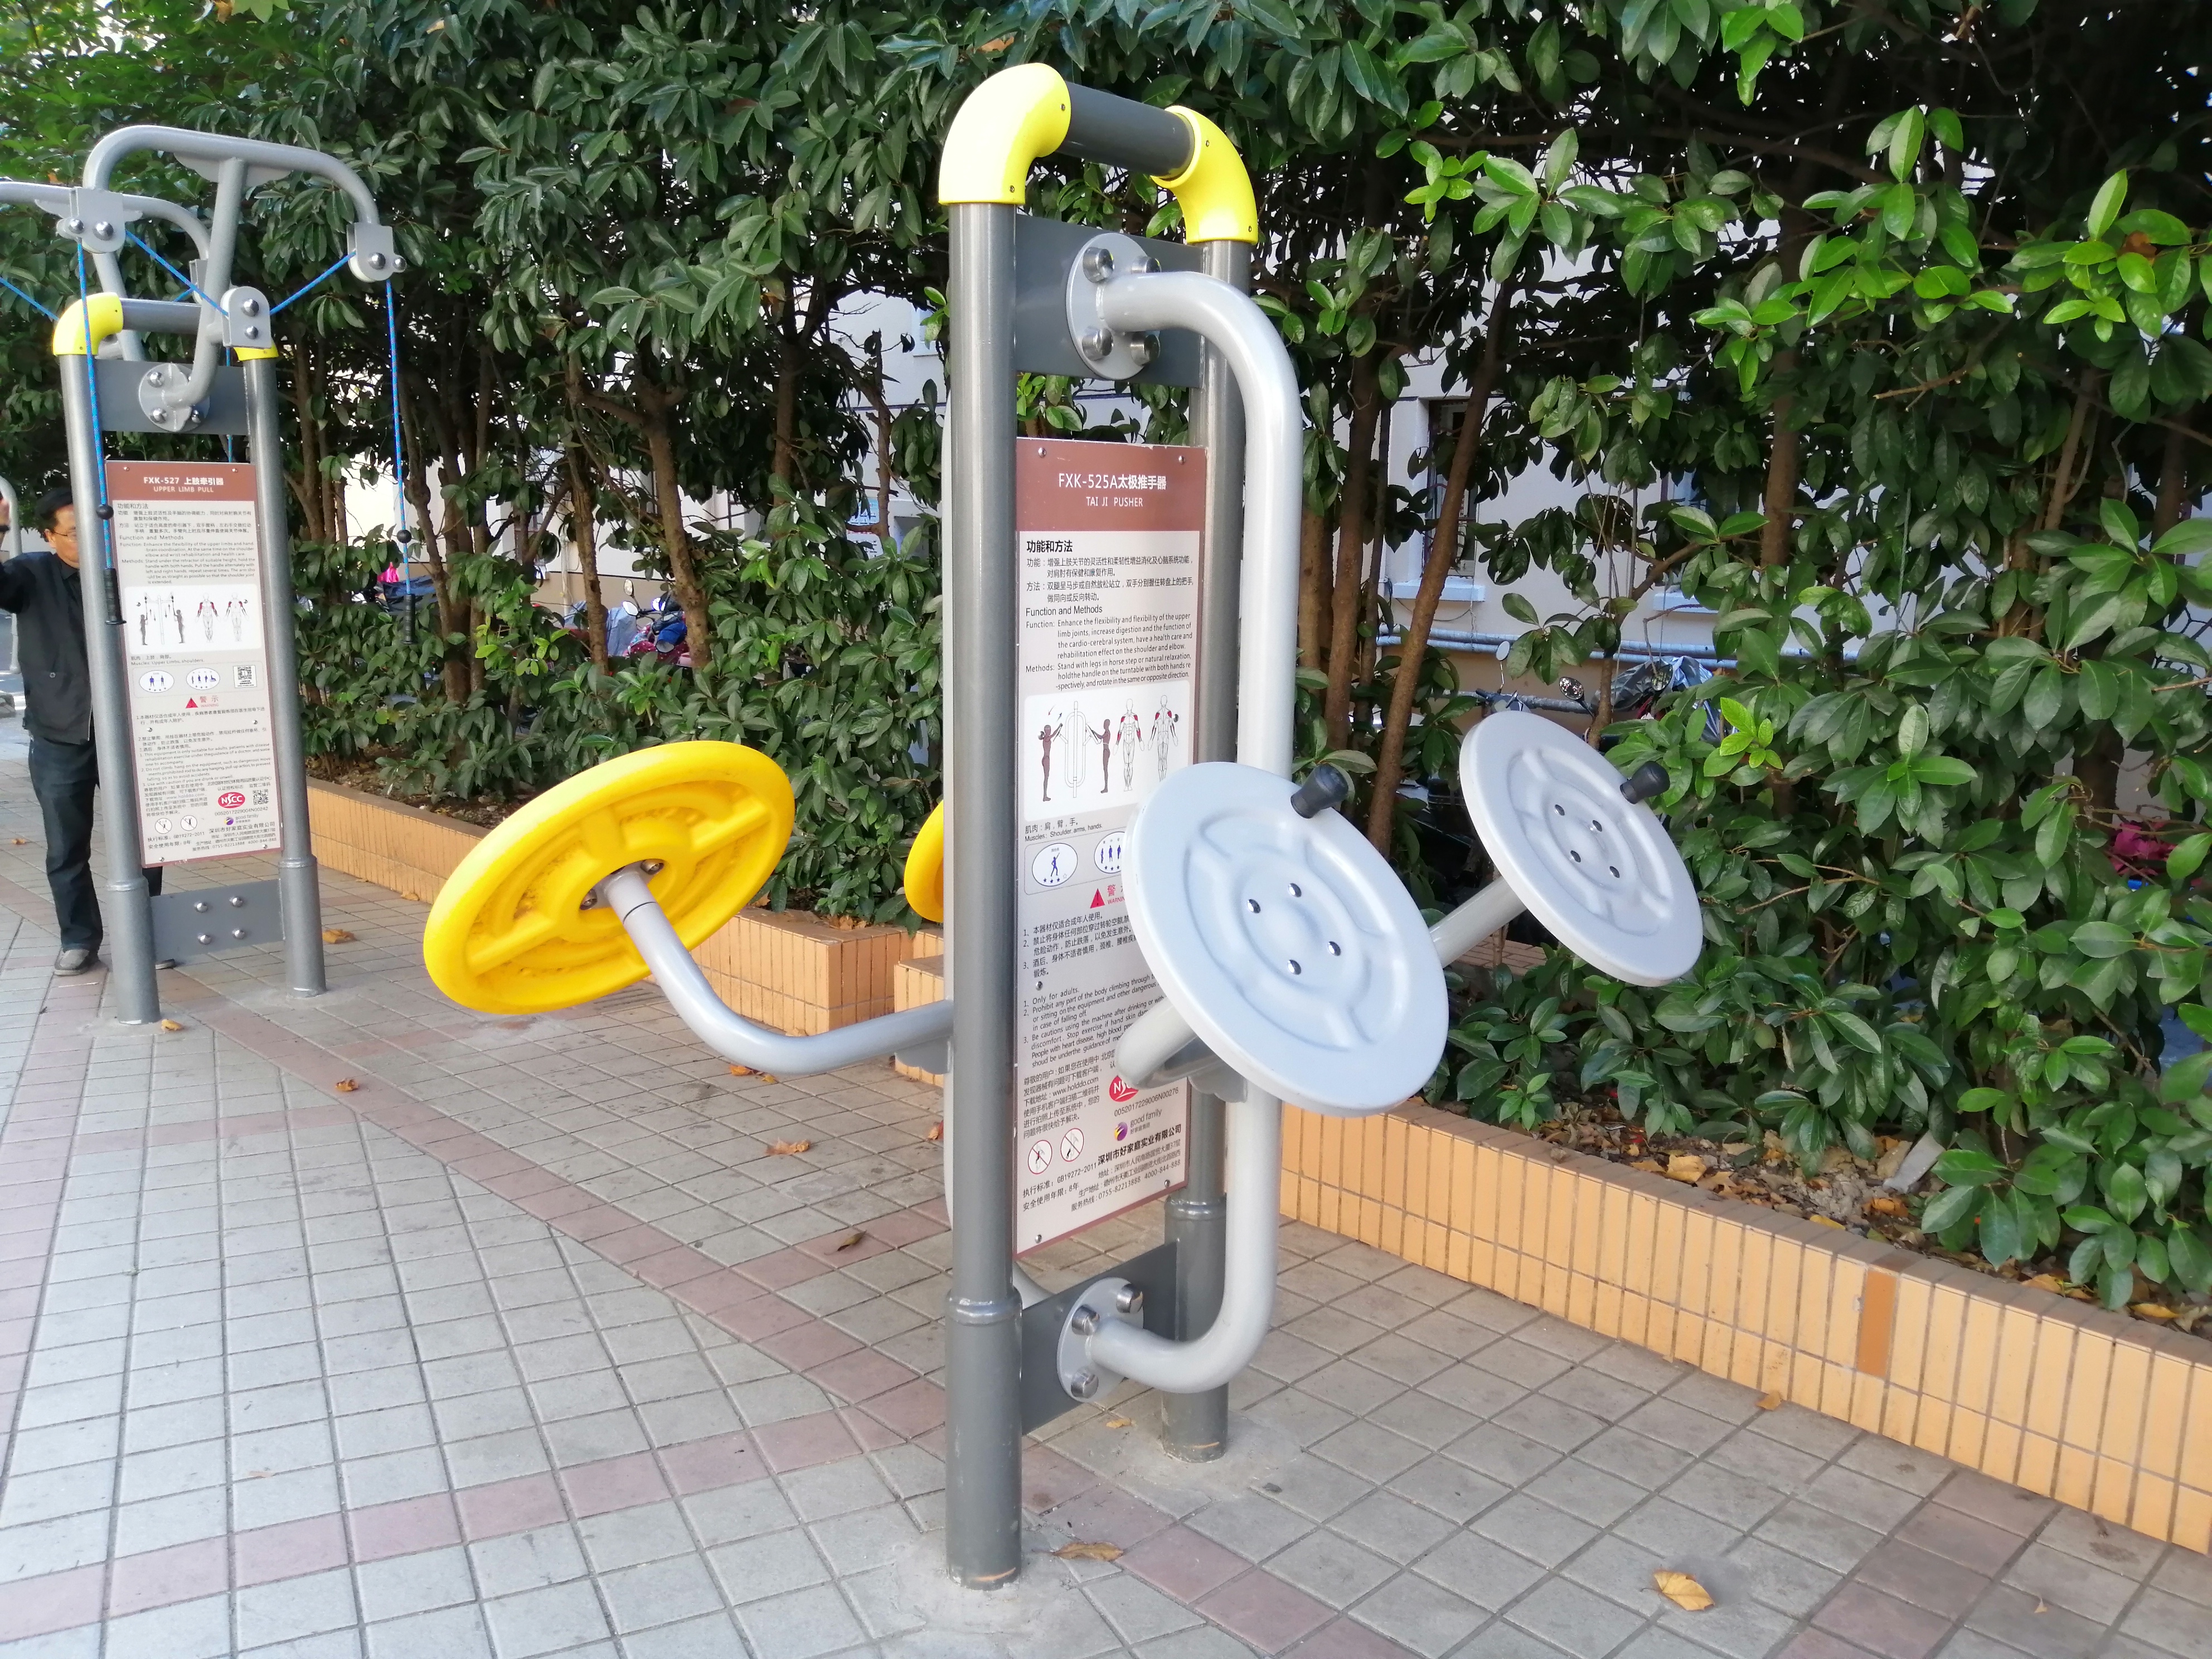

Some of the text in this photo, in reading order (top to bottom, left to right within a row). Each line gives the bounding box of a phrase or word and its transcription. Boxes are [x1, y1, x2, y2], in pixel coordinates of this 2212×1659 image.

[1086, 496, 1143, 507] TAI JI PUSHER
[1026, 540, 1073, 552] 功能和方法
[1026, 605, 1103, 617] Function and Methods
[1094, 616, 1120, 625] flexibility
[1071, 629, 1090, 638] joints,
[1116, 626, 1141, 635] digestion
[1069, 638, 1113, 647] cardio-cerebral
[1114, 637, 1134, 646] system,
[1026, 664, 1055, 672] Methods:
[1058, 662, 1074, 670] Stand
[1090, 660, 1101, 668] legs
[1120, 666, 1144, 674] turntable
[1147, 673, 1167, 682] opposite
[221, 794, 242, 805] NSCC
[1025, 833, 1047, 842] Muscles:
[1032, 1002, 1054, 1013] Prohibit
[1066, 996, 1076, 1006] part
[1094, 987, 1107, 996] body
[1109, 981, 1129, 992] climbing
[1131, 974, 1150, 986] through
[1032, 996, 1046, 1005] Only
[1060, 987, 1080, 997] adults.
[1041, 1011, 1058, 1021] sitting
[1078, 997, 1104, 1010] equipment
[1117, 989, 1130, 998] other
[1132, 982, 1156, 994] dangerous
[1041, 1027, 1063, 1038] cautions
[1065, 1022, 1079, 1031] using
[1092, 1012, 1113, 1023] machine
[1114, 1008, 1127, 1016] after
[1127, 1001, 1147, 1012] drinking
[1061, 1014, 1077, 1023] falling
[1067, 1031, 1079, 1040] Stop
[1081, 1023, 1103, 1035] exercise
[1111, 1016, 1124, 1026] hand
[1126, 1013, 1136, 1021] skin
[1032, 1049, 1049, 1059] People
[1050, 1045, 1060, 1053] with
[1062, 1040, 1075, 1050] heart
[1097, 1030, 1107, 1039] high
[1108, 1025, 1122, 1035] blood
[1032, 1056, 1048, 1068] shoud
[1083, 1040, 1105, 1054] guidance
[1130, 1108, 1162, 1128] good family
[1057, 1162, 1097, 1183] GB19272-2011
[1144, 1160, 1181, 1179] 4000-844-888
